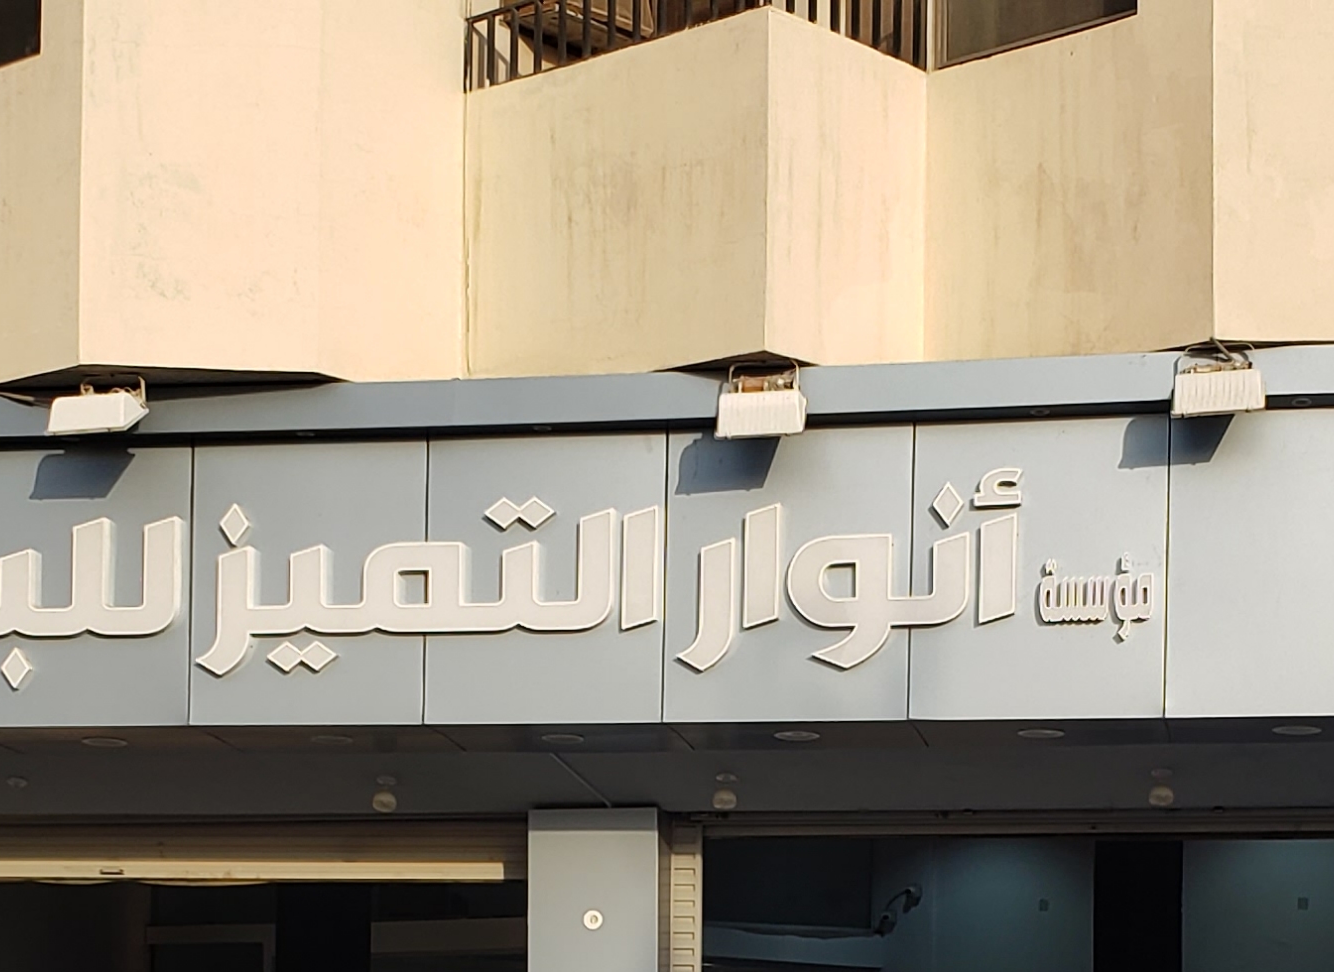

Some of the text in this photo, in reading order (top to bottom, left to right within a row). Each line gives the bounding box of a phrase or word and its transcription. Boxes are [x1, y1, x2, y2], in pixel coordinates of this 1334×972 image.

[195, 495, 660, 676] التميز
[675, 467, 1022, 673] أنوار
[1039, 552, 1154, 640] مؤسسة
